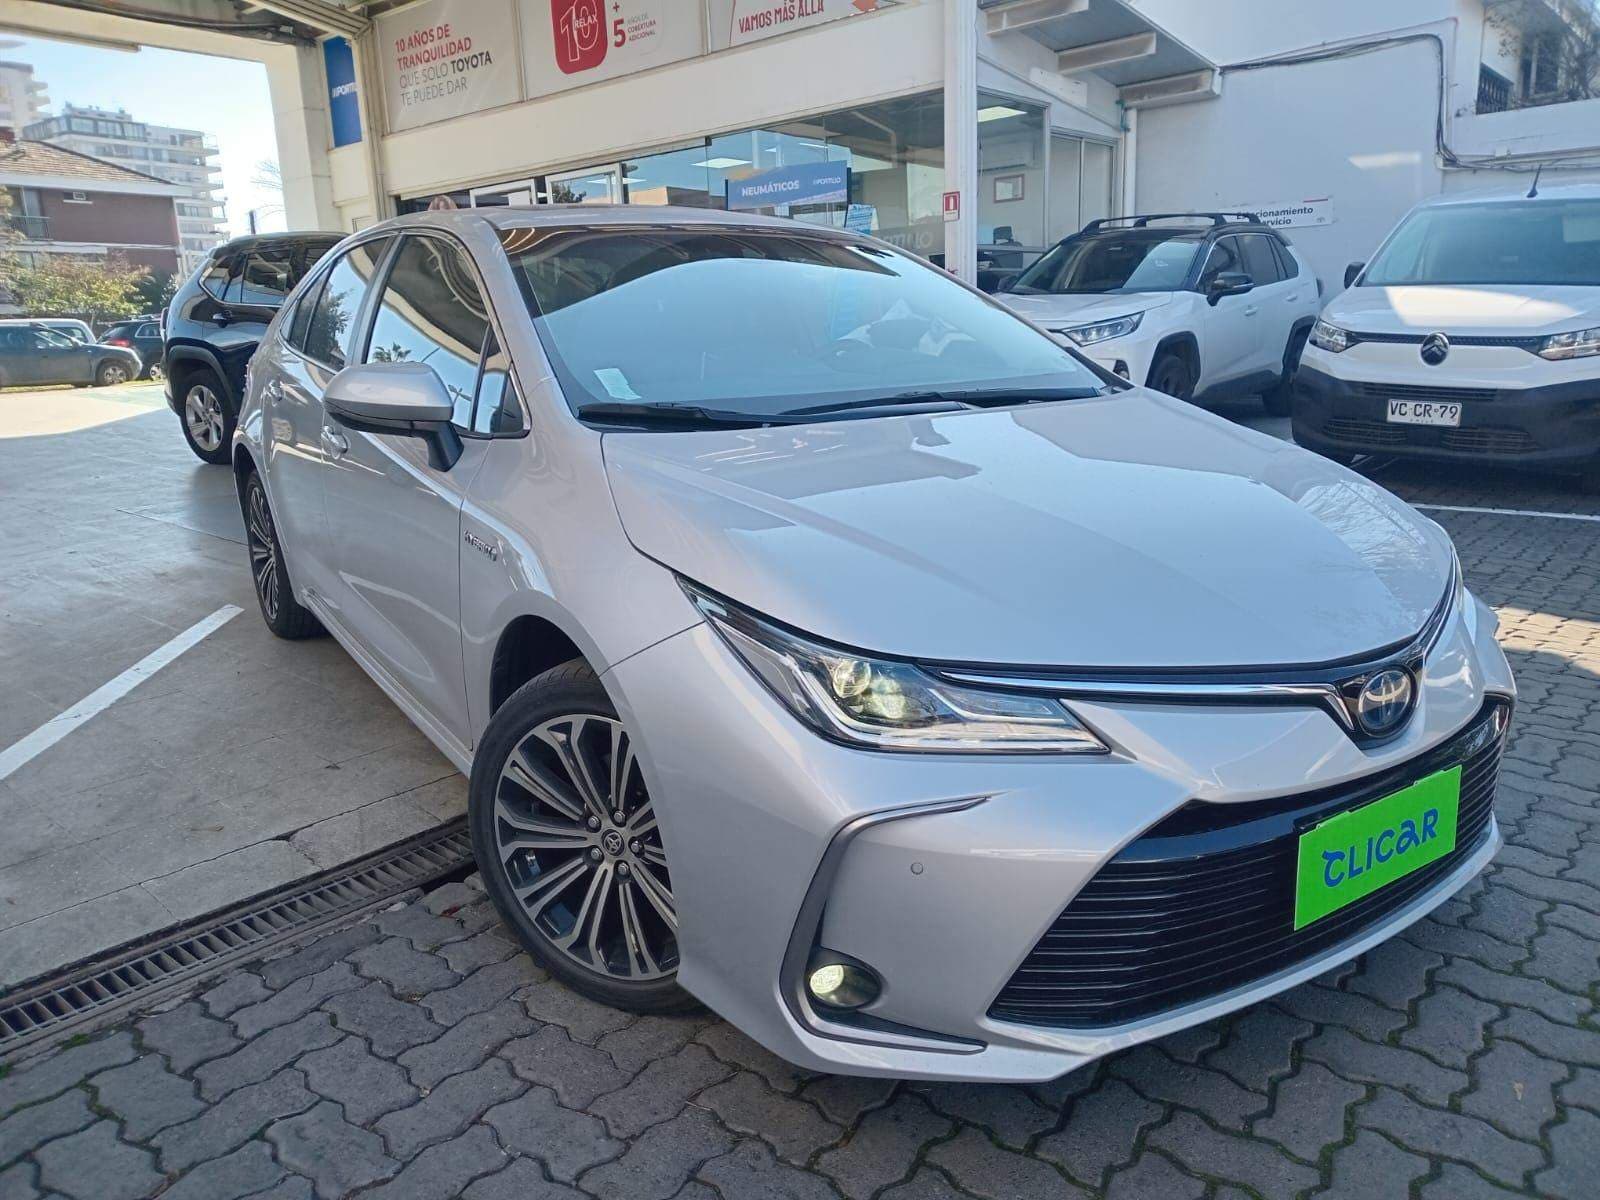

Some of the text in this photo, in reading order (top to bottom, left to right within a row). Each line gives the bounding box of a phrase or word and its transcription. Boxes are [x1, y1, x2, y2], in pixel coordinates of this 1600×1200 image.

[574, 14, 598, 28] RELAX
[612, 18, 626, 48] 5
[738, 10, 772, 34] VAMOS
[774, 2, 795, 24] MÁS
[395, 24, 450, 52] 10 AÑOS DE
[396, 37, 472, 71] TRANQUILIDAD
[400, 50, 492, 89] QUE SOLO TOYOTA
[401, 76, 467, 106] TE PUEDE DAR
[742, 180, 799, 197] NEUMÁTICOS
